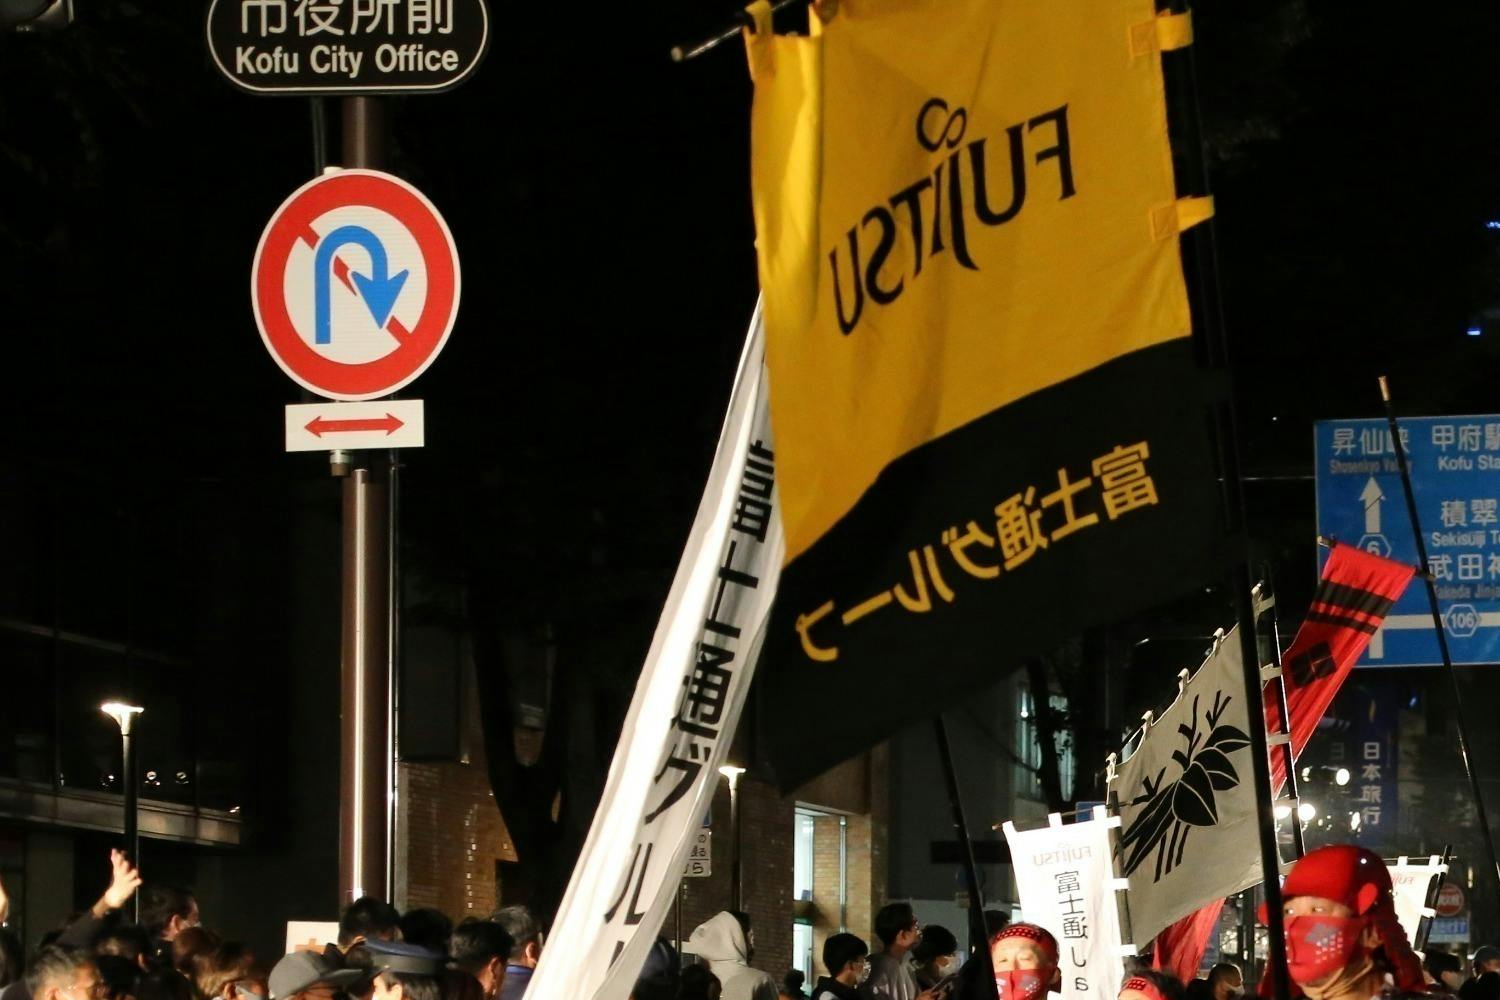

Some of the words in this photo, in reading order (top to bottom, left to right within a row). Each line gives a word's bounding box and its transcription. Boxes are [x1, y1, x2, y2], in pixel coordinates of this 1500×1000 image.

[241, 0, 454, 37] 市役所前
[236, 46, 299, 74] Kofu
[309, 44, 363, 79] City
[375, 43, 459, 73] Office
[1438, 456, 1473, 471] Kofu
[1450, 613, 1475, 629] 106
[1361, 741, 1383, 826] 日本旅行
